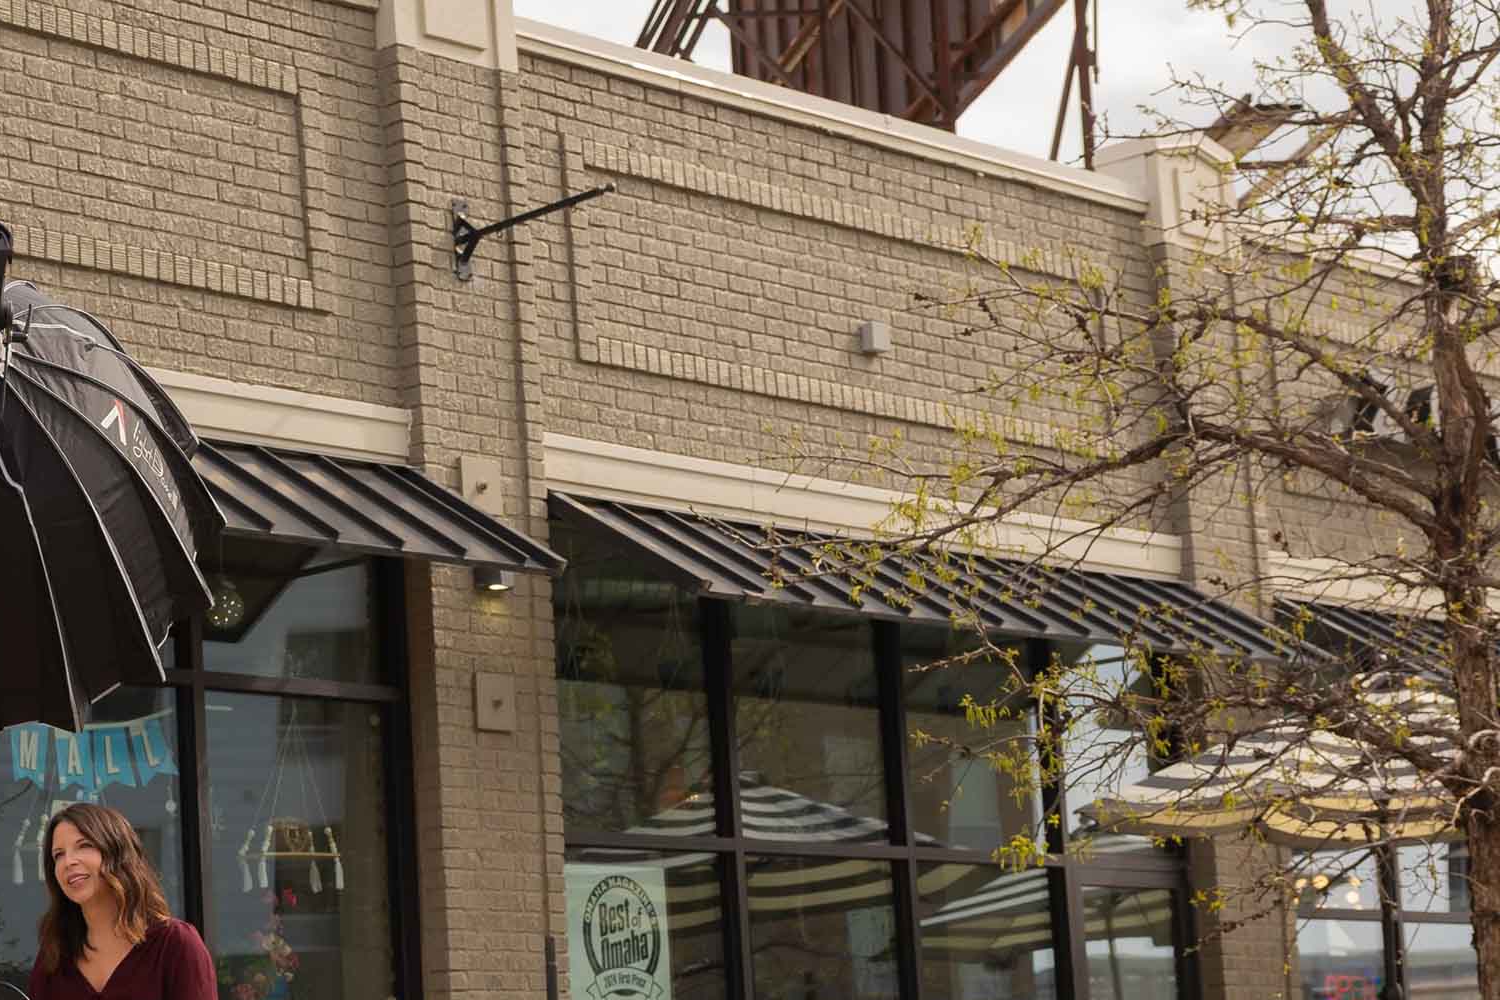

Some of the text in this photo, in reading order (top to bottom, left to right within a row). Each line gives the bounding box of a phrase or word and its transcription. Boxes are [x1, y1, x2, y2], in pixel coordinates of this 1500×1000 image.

[19, 721, 160, 775] MALL
[599, 899, 630, 936] Best
[601, 930, 649, 969] Omaha
